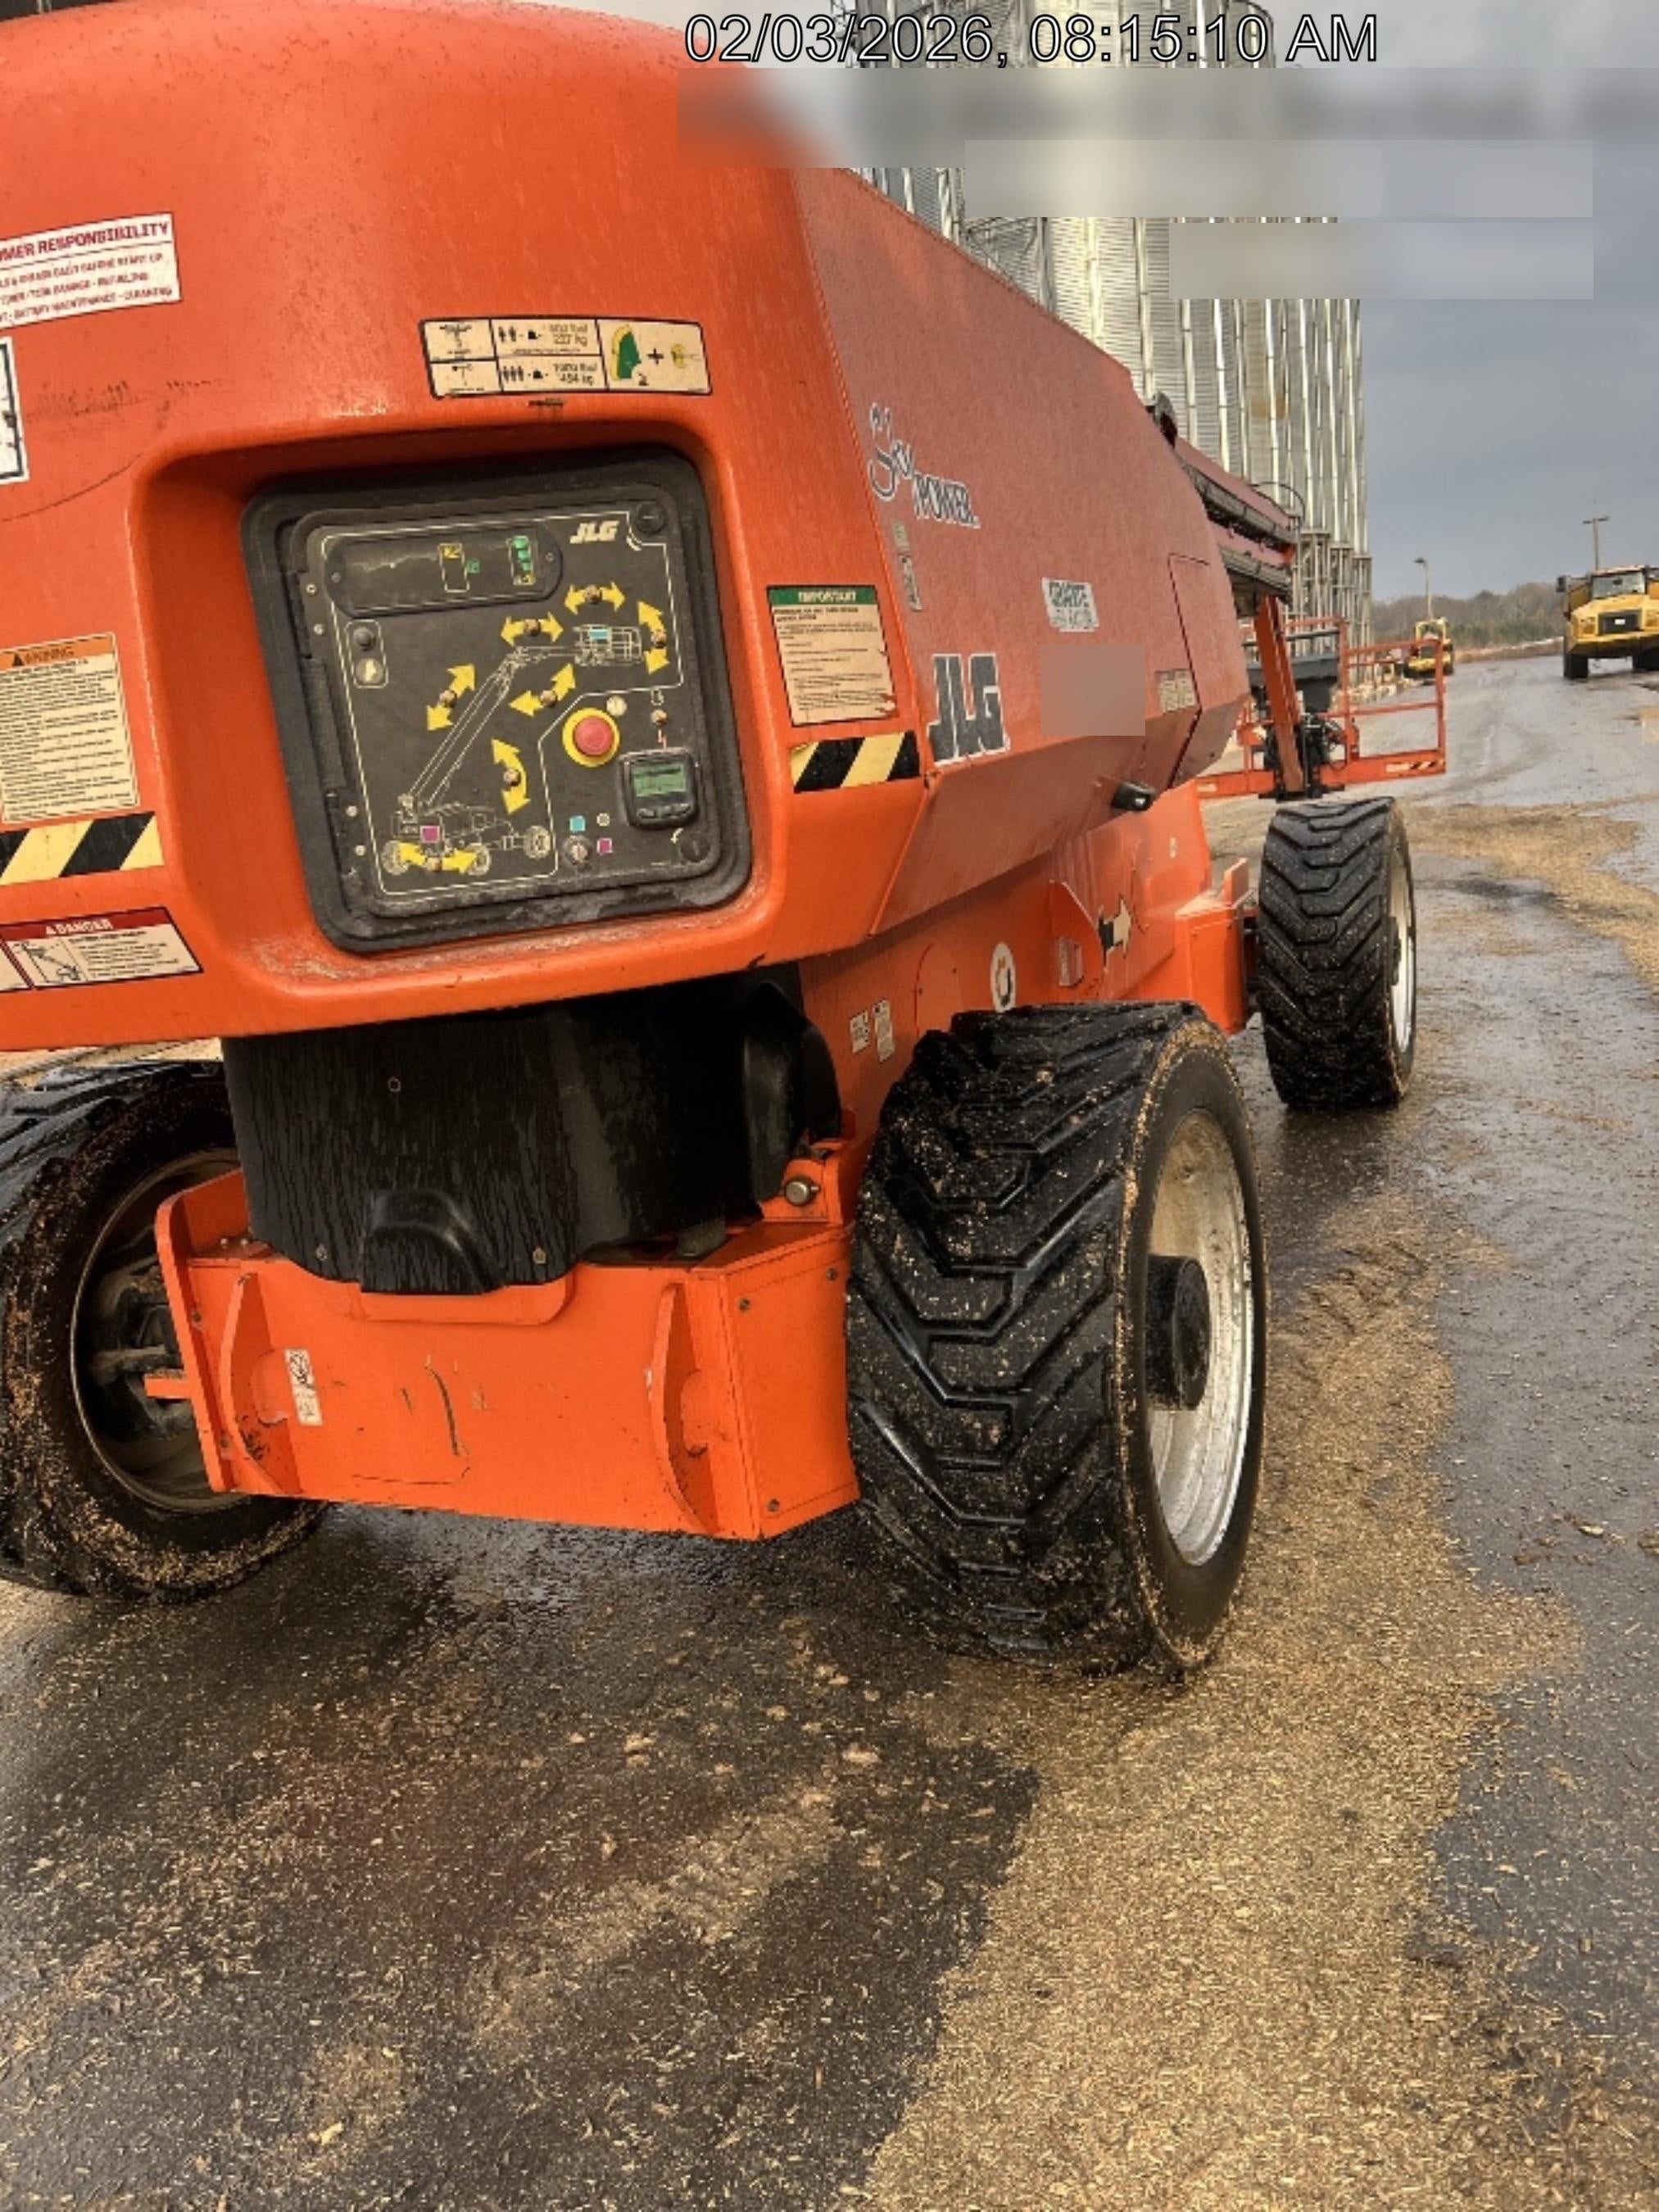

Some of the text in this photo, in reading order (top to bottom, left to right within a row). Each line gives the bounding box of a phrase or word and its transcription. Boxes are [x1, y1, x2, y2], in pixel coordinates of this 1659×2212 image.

[39, 222, 169, 253] RESPONSIBILITY
[569, 520, 619, 545] JLG
[927, 653, 1010, 767] JLG
[56, 918, 114, 935] DANGER
